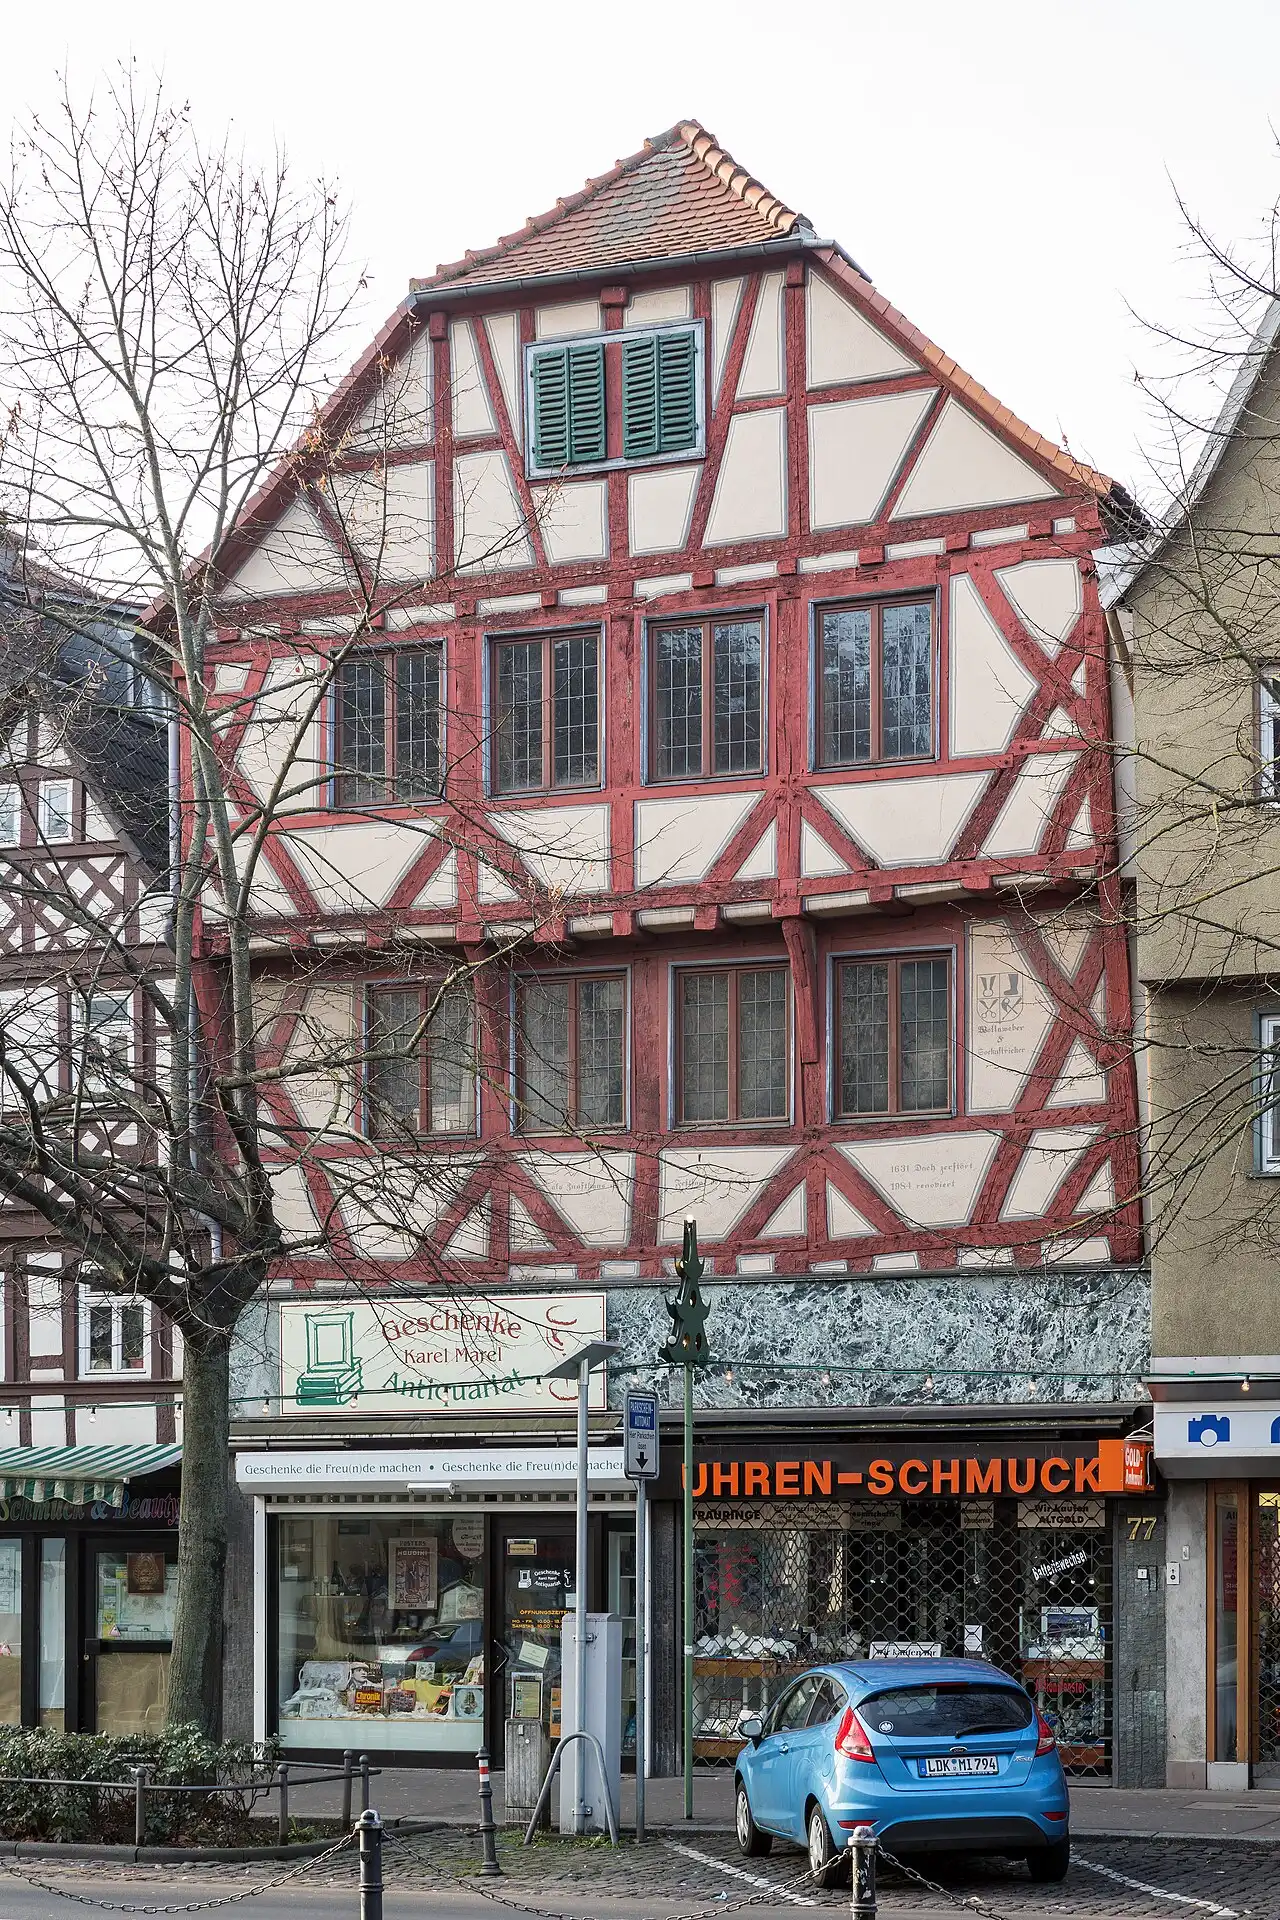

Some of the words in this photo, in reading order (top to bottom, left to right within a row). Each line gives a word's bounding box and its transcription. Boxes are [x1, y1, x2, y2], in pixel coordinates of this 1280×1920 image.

[382, 1309, 522, 1342] Geschenke
[404, 1347, 448, 1364] Karel
[382, 1367, 526, 1407] Antiquariat
[1125, 1447, 1143, 1467] GOLD-
[244, 1464, 302, 1475] Geschenke
[305, 1463, 322, 1474] die
[325, 1463, 376, 1475] Freu(n)de
[379, 1462, 422, 1474] machen
[442, 1461, 502, 1473] Geschenke
[505, 1460, 523, 1472] die
[526, 1460, 578, 1472] Freu(n)de
[90, 1500, 109, 1520] &
[692, 1510, 761, 1521] TRAURINGE
[1039, 1515, 1084, 1524] ALTGOLD
[1127, 1517, 1157, 1540] 77
[356, 1691, 381, 1700] Chronik
[928, 1759, 951, 1773] LDK
[959, 1758, 973, 1771] MI
[974, 1757, 996, 1771] 794
